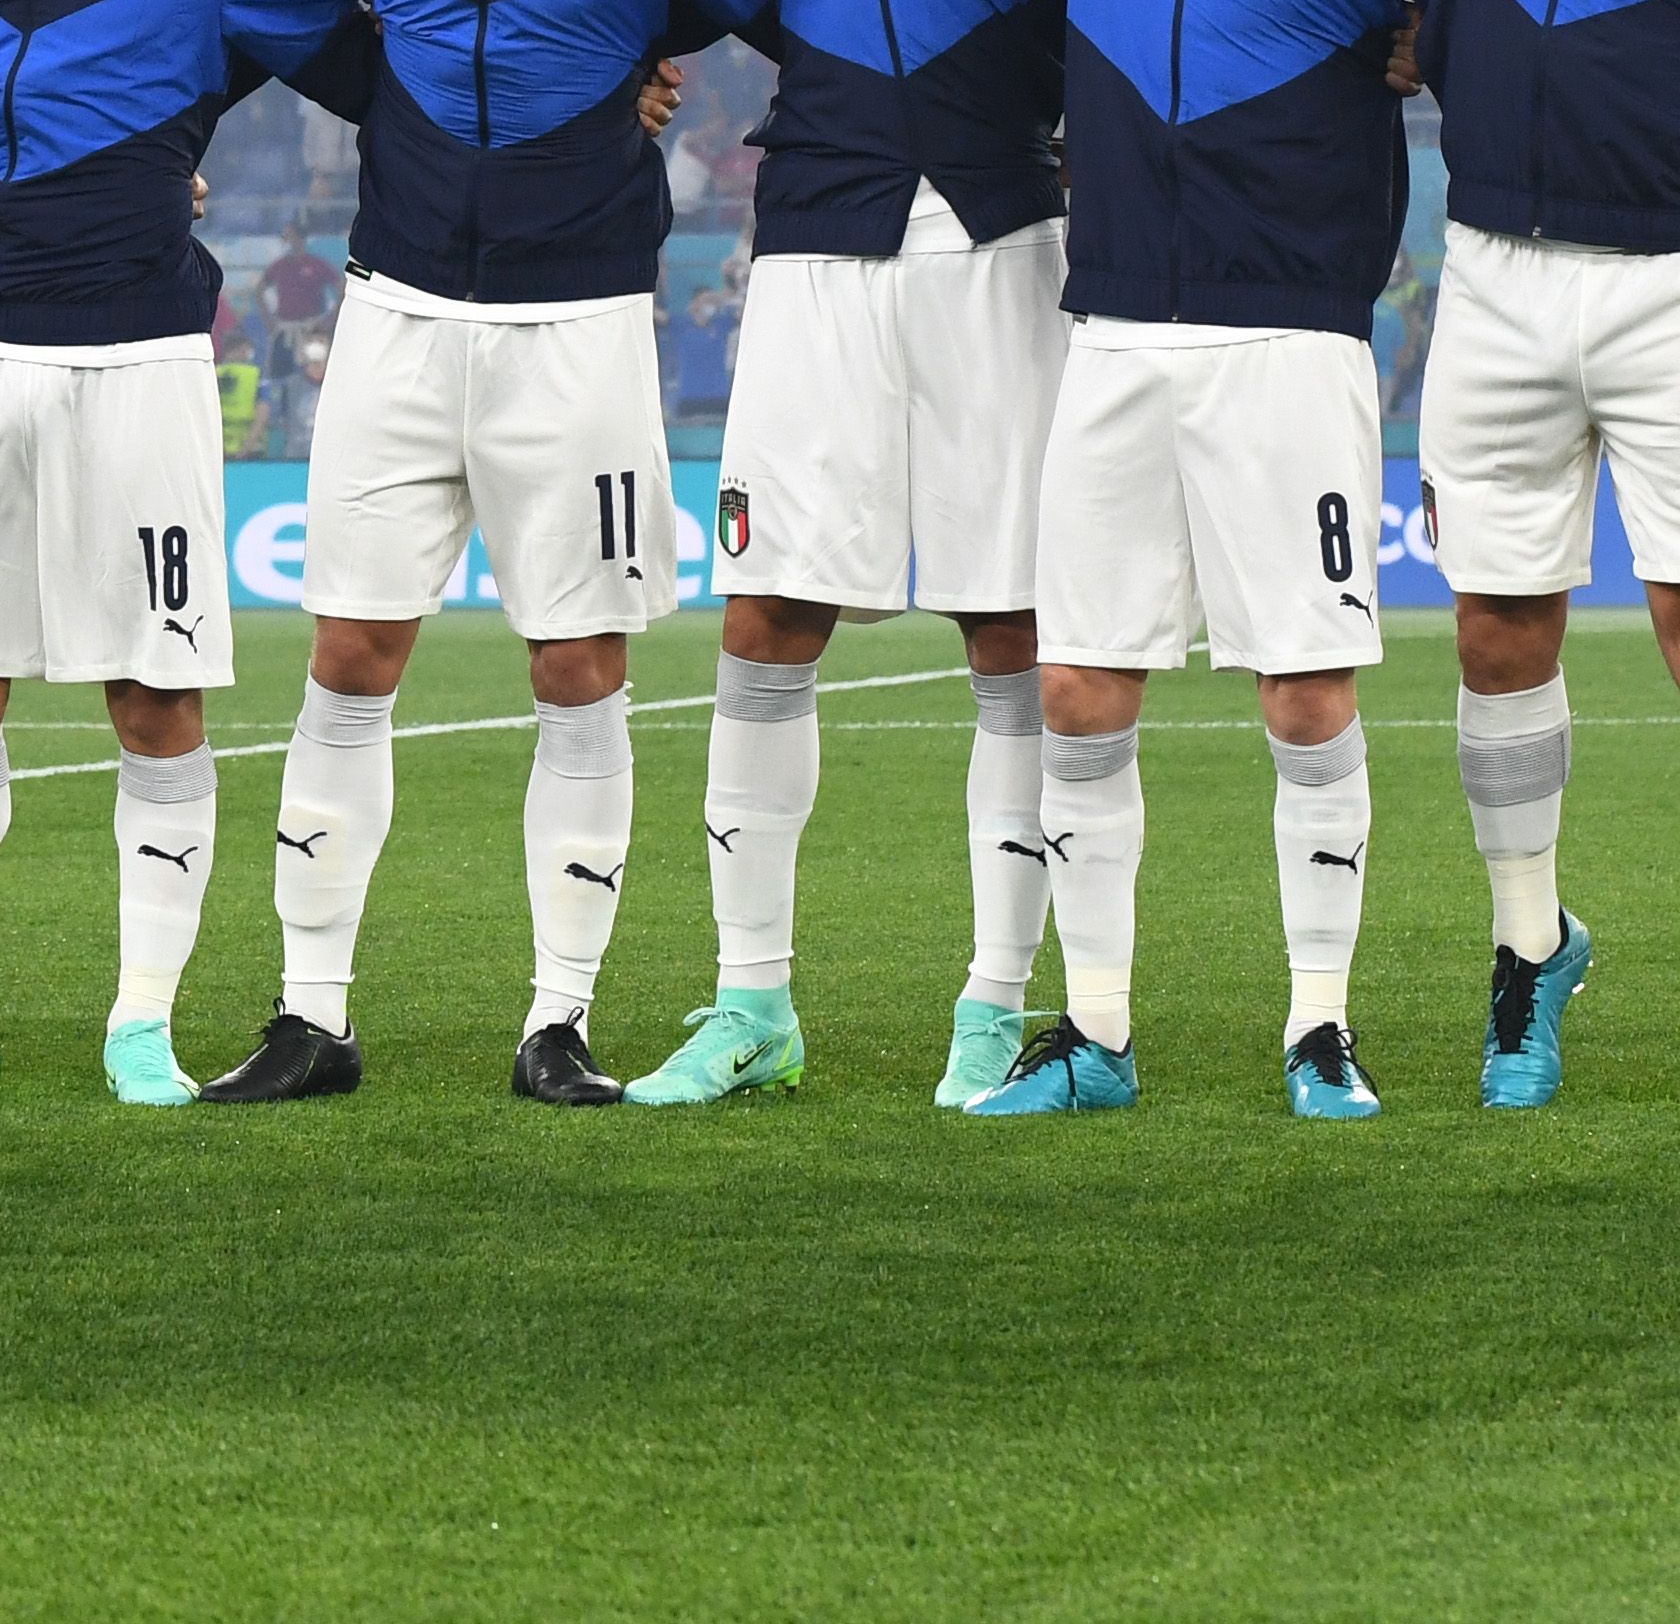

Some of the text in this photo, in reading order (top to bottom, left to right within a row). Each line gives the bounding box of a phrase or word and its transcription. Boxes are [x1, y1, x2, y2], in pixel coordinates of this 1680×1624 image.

[594, 470, 636, 561] 11
[1316, 491, 1354, 583] 8
[137, 526, 188, 612] 18
